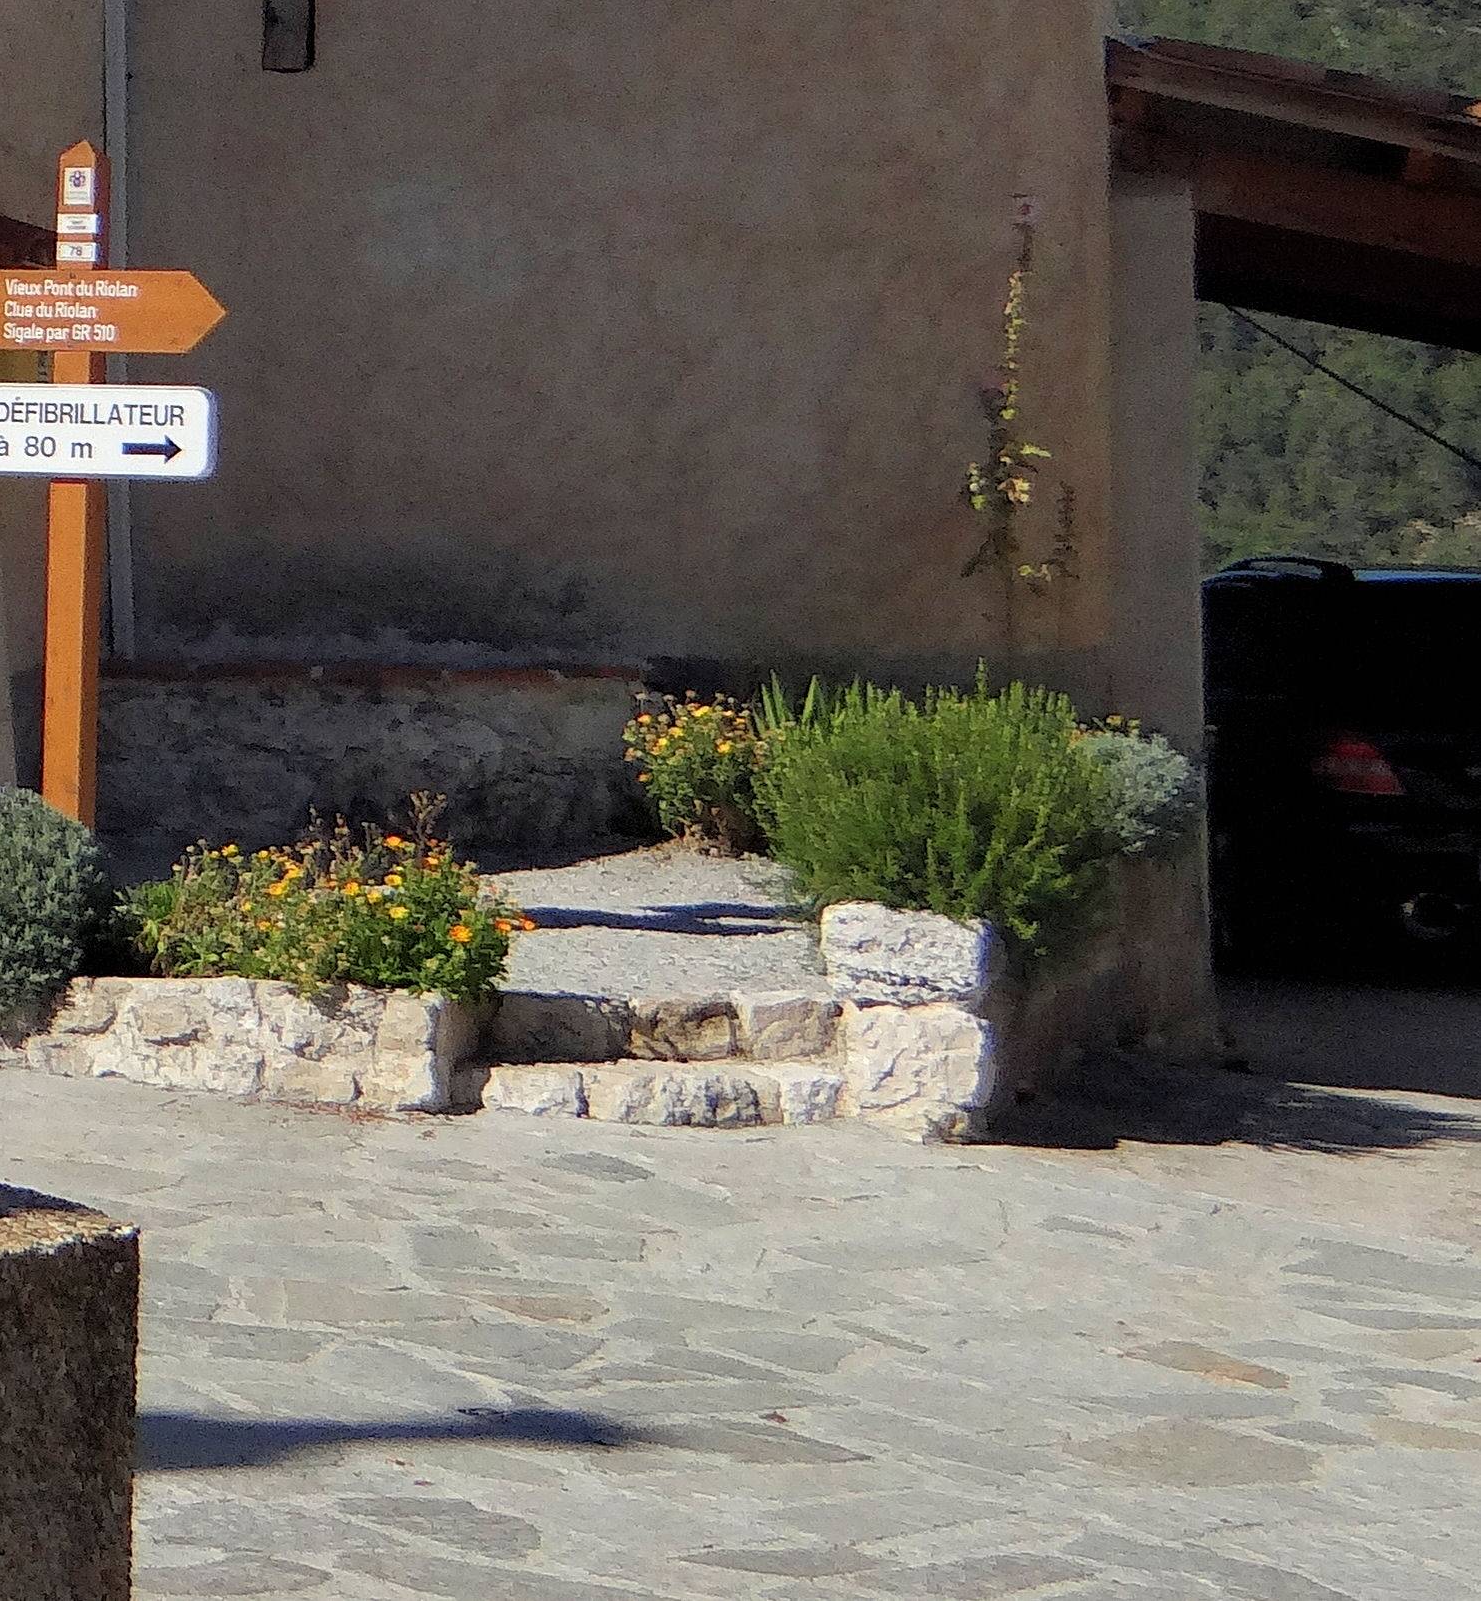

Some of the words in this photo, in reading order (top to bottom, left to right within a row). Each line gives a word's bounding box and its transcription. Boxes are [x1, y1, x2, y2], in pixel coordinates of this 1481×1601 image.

[69, 246, 83, 257] 78
[5, 279, 42, 296] Vieux
[44, 279, 74, 297] Pont
[76, 280, 94, 297] du
[95, 280, 138, 298] Riolan
[4, 301, 34, 318] Clue
[36, 302, 54, 319] du
[55, 302, 97, 319] Riolan
[3, 322, 44, 343] Sigale
[46, 328, 70, 343] par
[72, 325, 92, 341] GR
[93, 325, 116, 342] 510
[23, 436, 56, 459] 80
[71, 442, 93, 459] m
